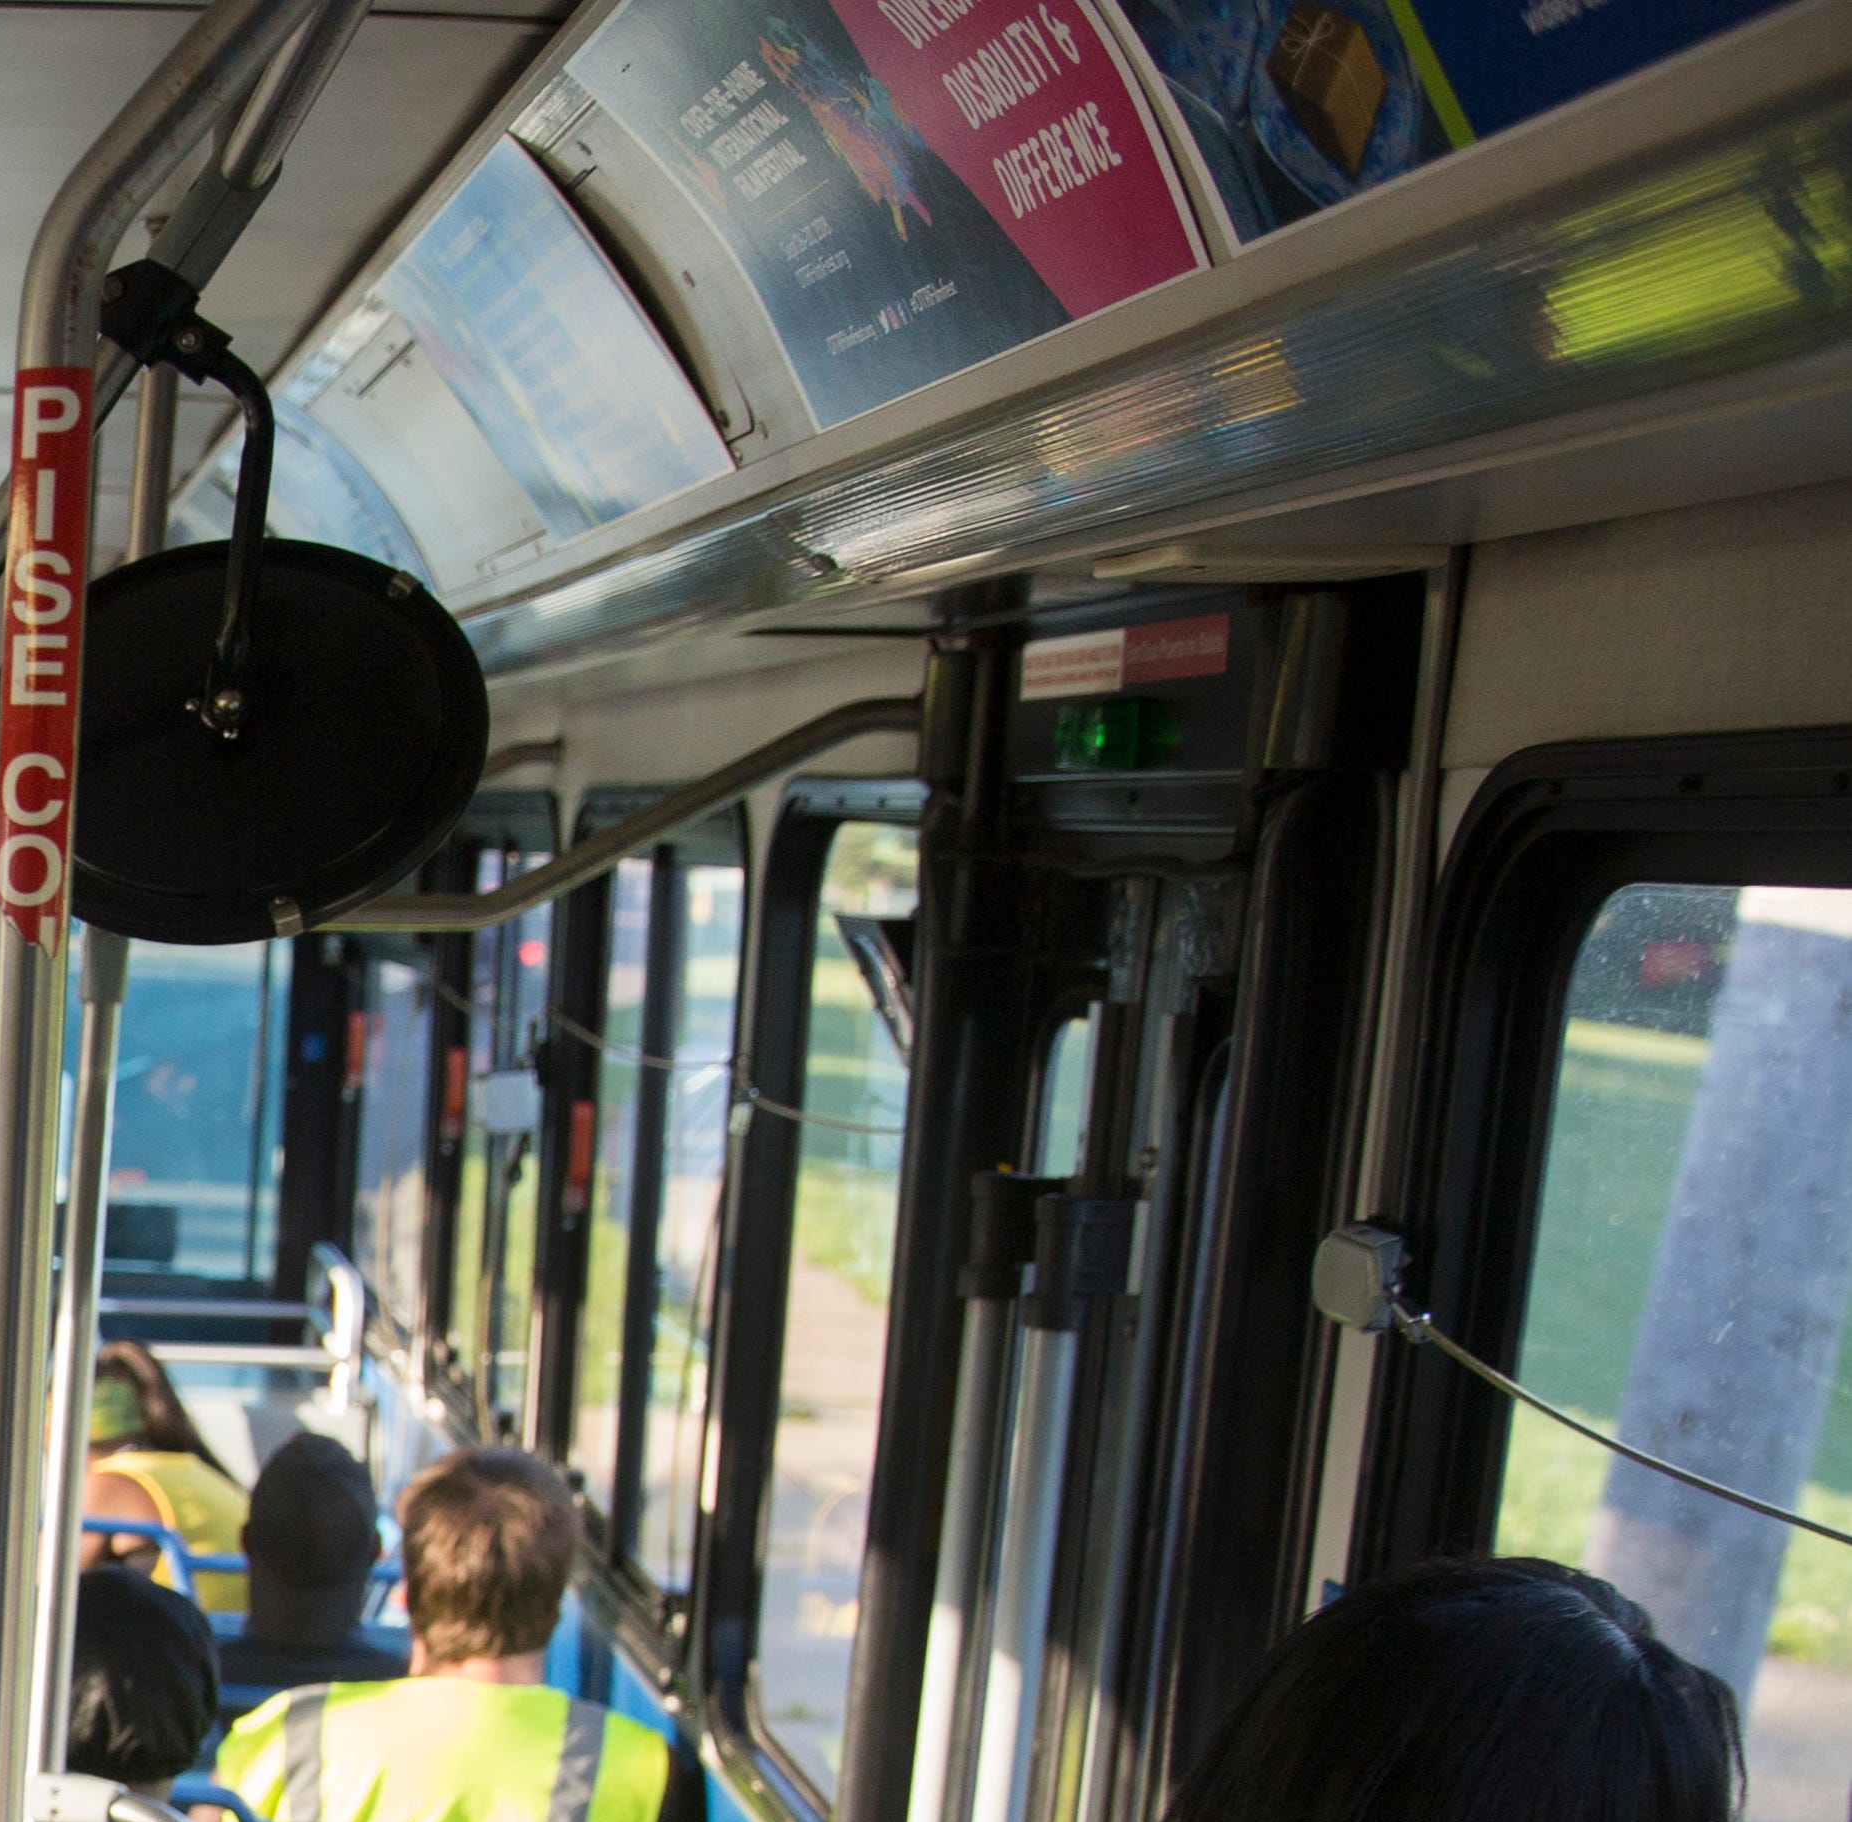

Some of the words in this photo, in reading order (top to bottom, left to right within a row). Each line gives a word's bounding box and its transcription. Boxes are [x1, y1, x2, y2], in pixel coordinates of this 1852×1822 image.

[942, 15, 1062, 130] DISABILITY
[1038, 3, 1081, 65] &
[707, 98, 790, 170] INTERNATIONAL
[993, 101, 1123, 219] DIFFERENCE
[10, 385, 81, 706] PISE
